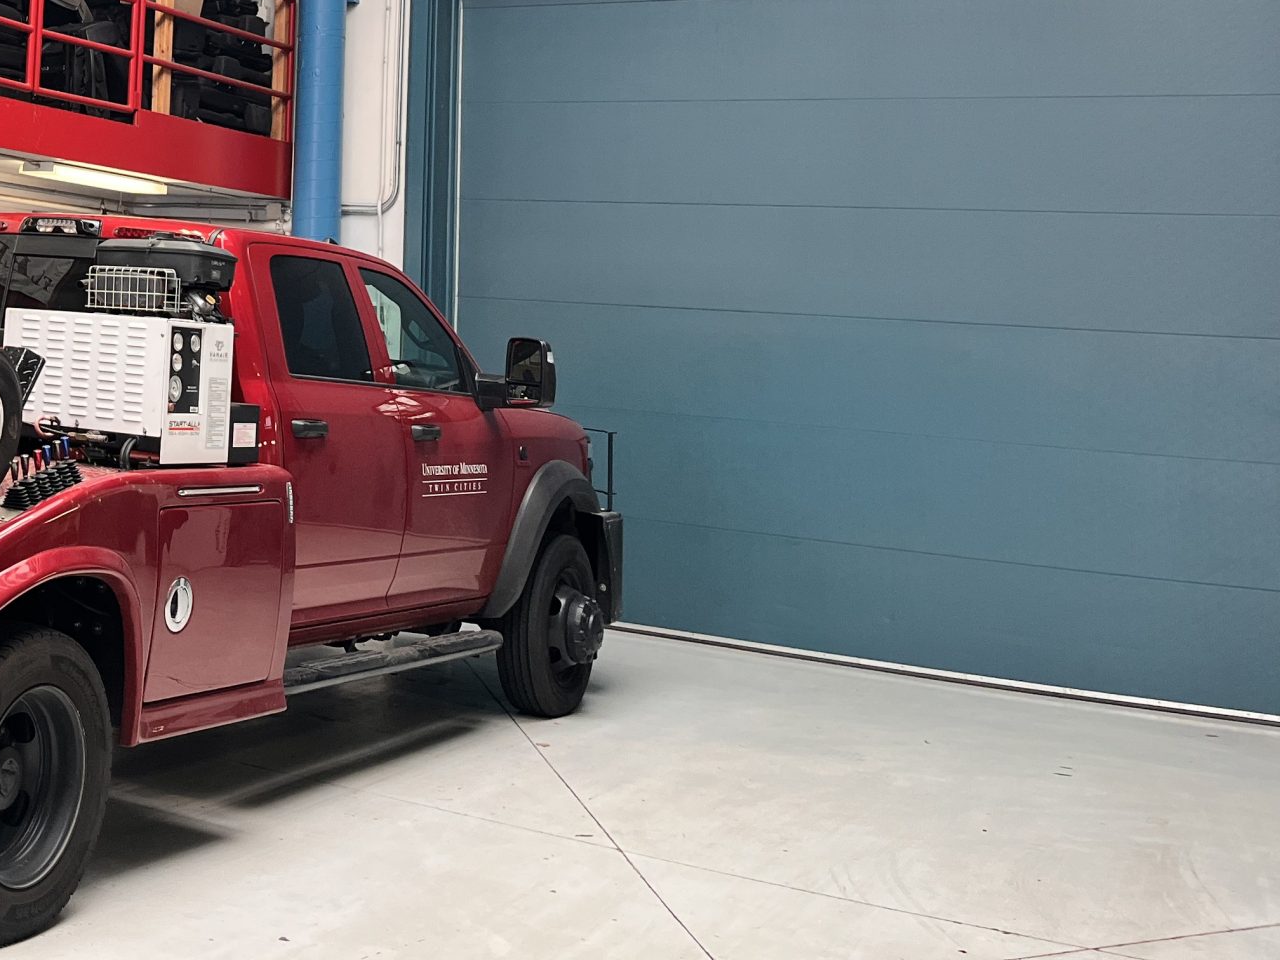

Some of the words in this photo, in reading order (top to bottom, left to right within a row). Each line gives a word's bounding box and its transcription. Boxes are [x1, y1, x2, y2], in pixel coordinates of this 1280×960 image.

[422, 464, 452, 476] UNIVERSITY
[460, 462, 488, 475] MINNESOTA
[429, 484, 450, 493] TWIN
[454, 482, 482, 492] CITIES
